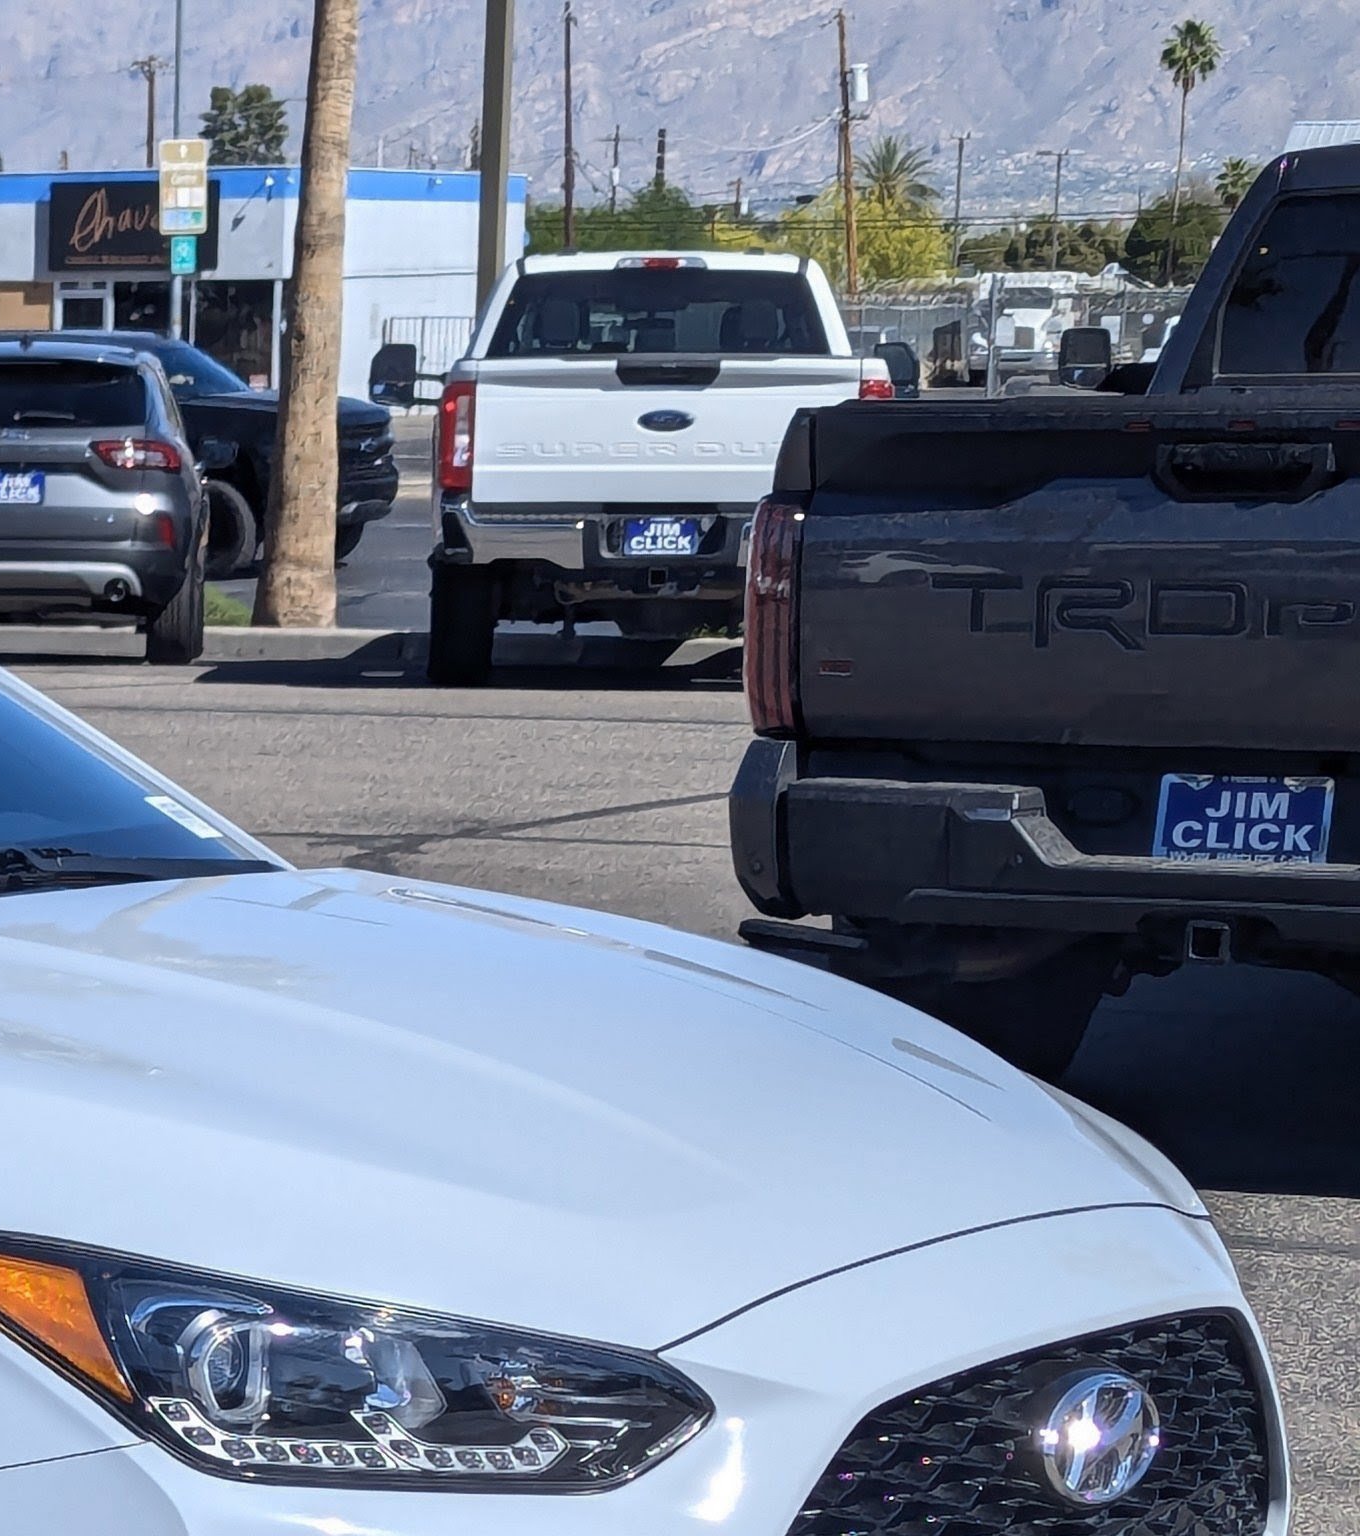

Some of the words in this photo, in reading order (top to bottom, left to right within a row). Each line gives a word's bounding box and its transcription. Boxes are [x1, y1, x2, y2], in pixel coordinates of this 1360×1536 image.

[495, 441, 679, 457] SUPER
[693, 441, 779, 457] DU
[643, 522, 681, 537] JIM
[630, 535, 692, 549] CLICK
[1205, 790, 1290, 820] JIM
[1172, 820, 1316, 852] CLICK
